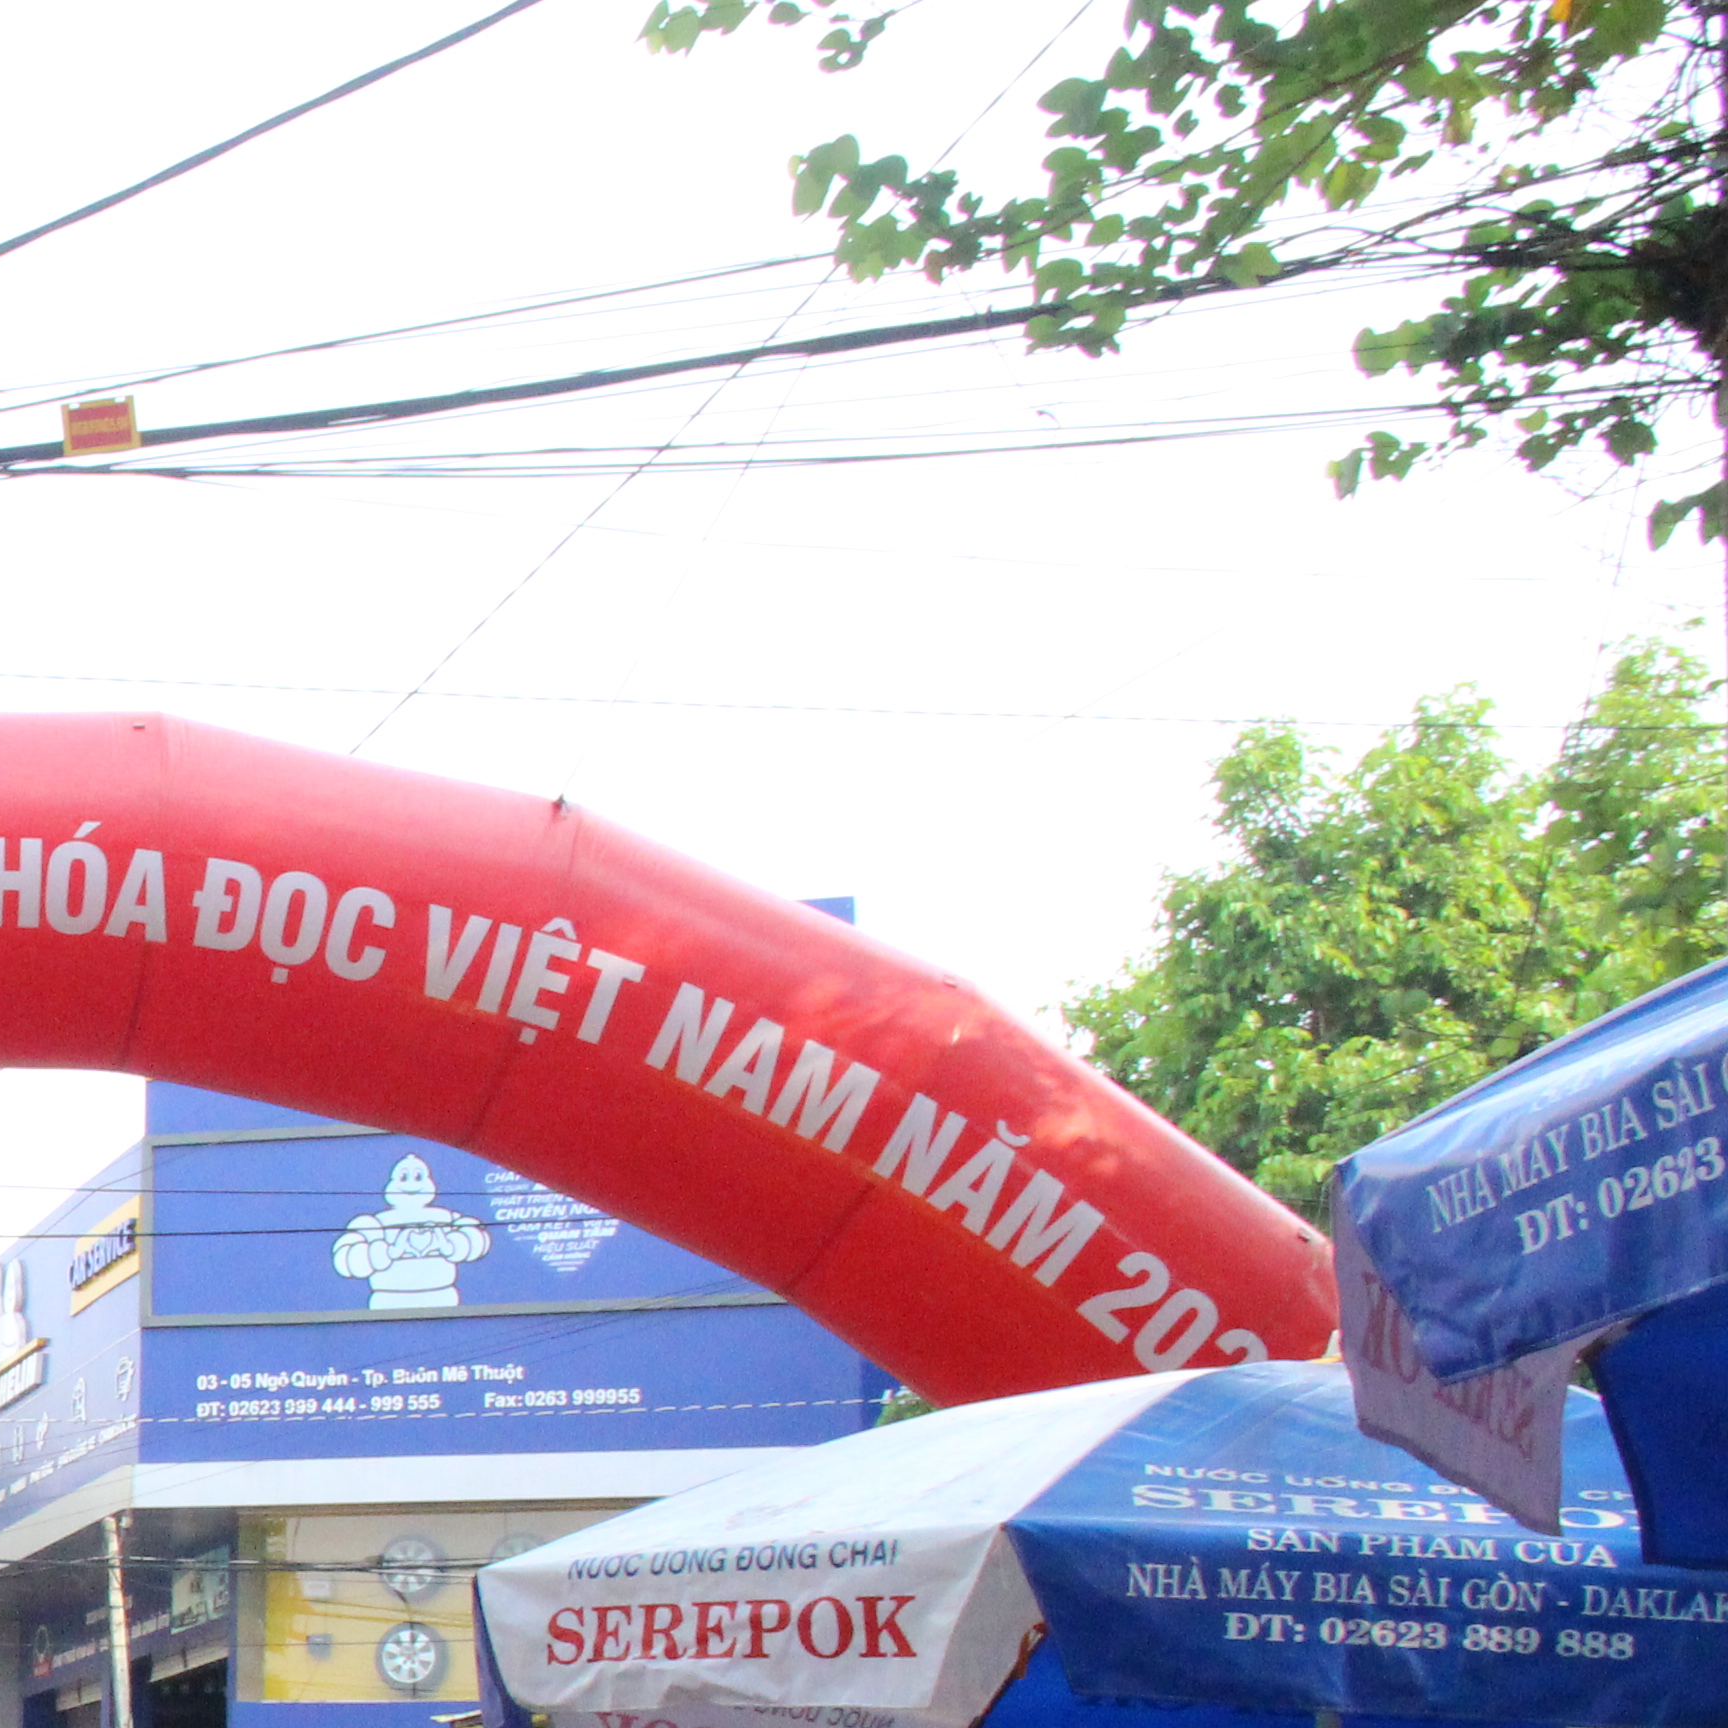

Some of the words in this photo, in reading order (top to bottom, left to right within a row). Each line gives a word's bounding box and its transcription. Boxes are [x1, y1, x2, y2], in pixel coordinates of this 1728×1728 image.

[192, 857, 395, 985] ĐỌC
[419, 902, 648, 1044] VIỆT
[645, 981, 882, 1155] NAM
[870, 1091, 1107, 1289] NĂM
[1072, 1253, 1270, 1371] 202
[1580, 1097, 1648, 1160] BIA
[1652, 1061, 1717, 1131] SÀI
[1515, 1193, 1589, 1255] ĐT:
[1598, 1136, 1726, 1219] 02623
[196, 1402, 225, 1418] ĐT:
[228, 1400, 281, 1416] 02623
[322, 1398, 356, 1412] 444
[370, 1395, 403, 1412] 999
[407, 1394, 441, 1410] 555
[483, 1392, 523, 1408] Fax:
[525, 1390, 567, 1407] 0263
[572, 1388, 640, 1405] 999955
[197, 1375, 218, 1390] 03
[230, 1373, 251, 1389] 05
[255, 1371, 289, 1391] Ngô
[292, 1367, 348, 1390] Quyền
[361, 1369, 388, 1388] Tp.
[442, 1366, 468, 1382] Mê
[471, 1363, 524, 1384] Thuột
[828, 1538, 899, 1569] CHAI
[1126, 1556, 1207, 1600] NHÀ
[1217, 1562, 1302, 1600] MÁY
[1312, 1572, 1376, 1605] BIA
[1387, 1567, 1452, 1608] SÀI
[1461, 1572, 1545, 1612] GÒN
[547, 1595, 918, 1665] SEREPOK
[1223, 1612, 1306, 1642] ĐT:
[1319, 1616, 1448, 1650] 02623
[1462, 1623, 1541, 1654] 889
[1555, 1629, 1636, 1660] 888
